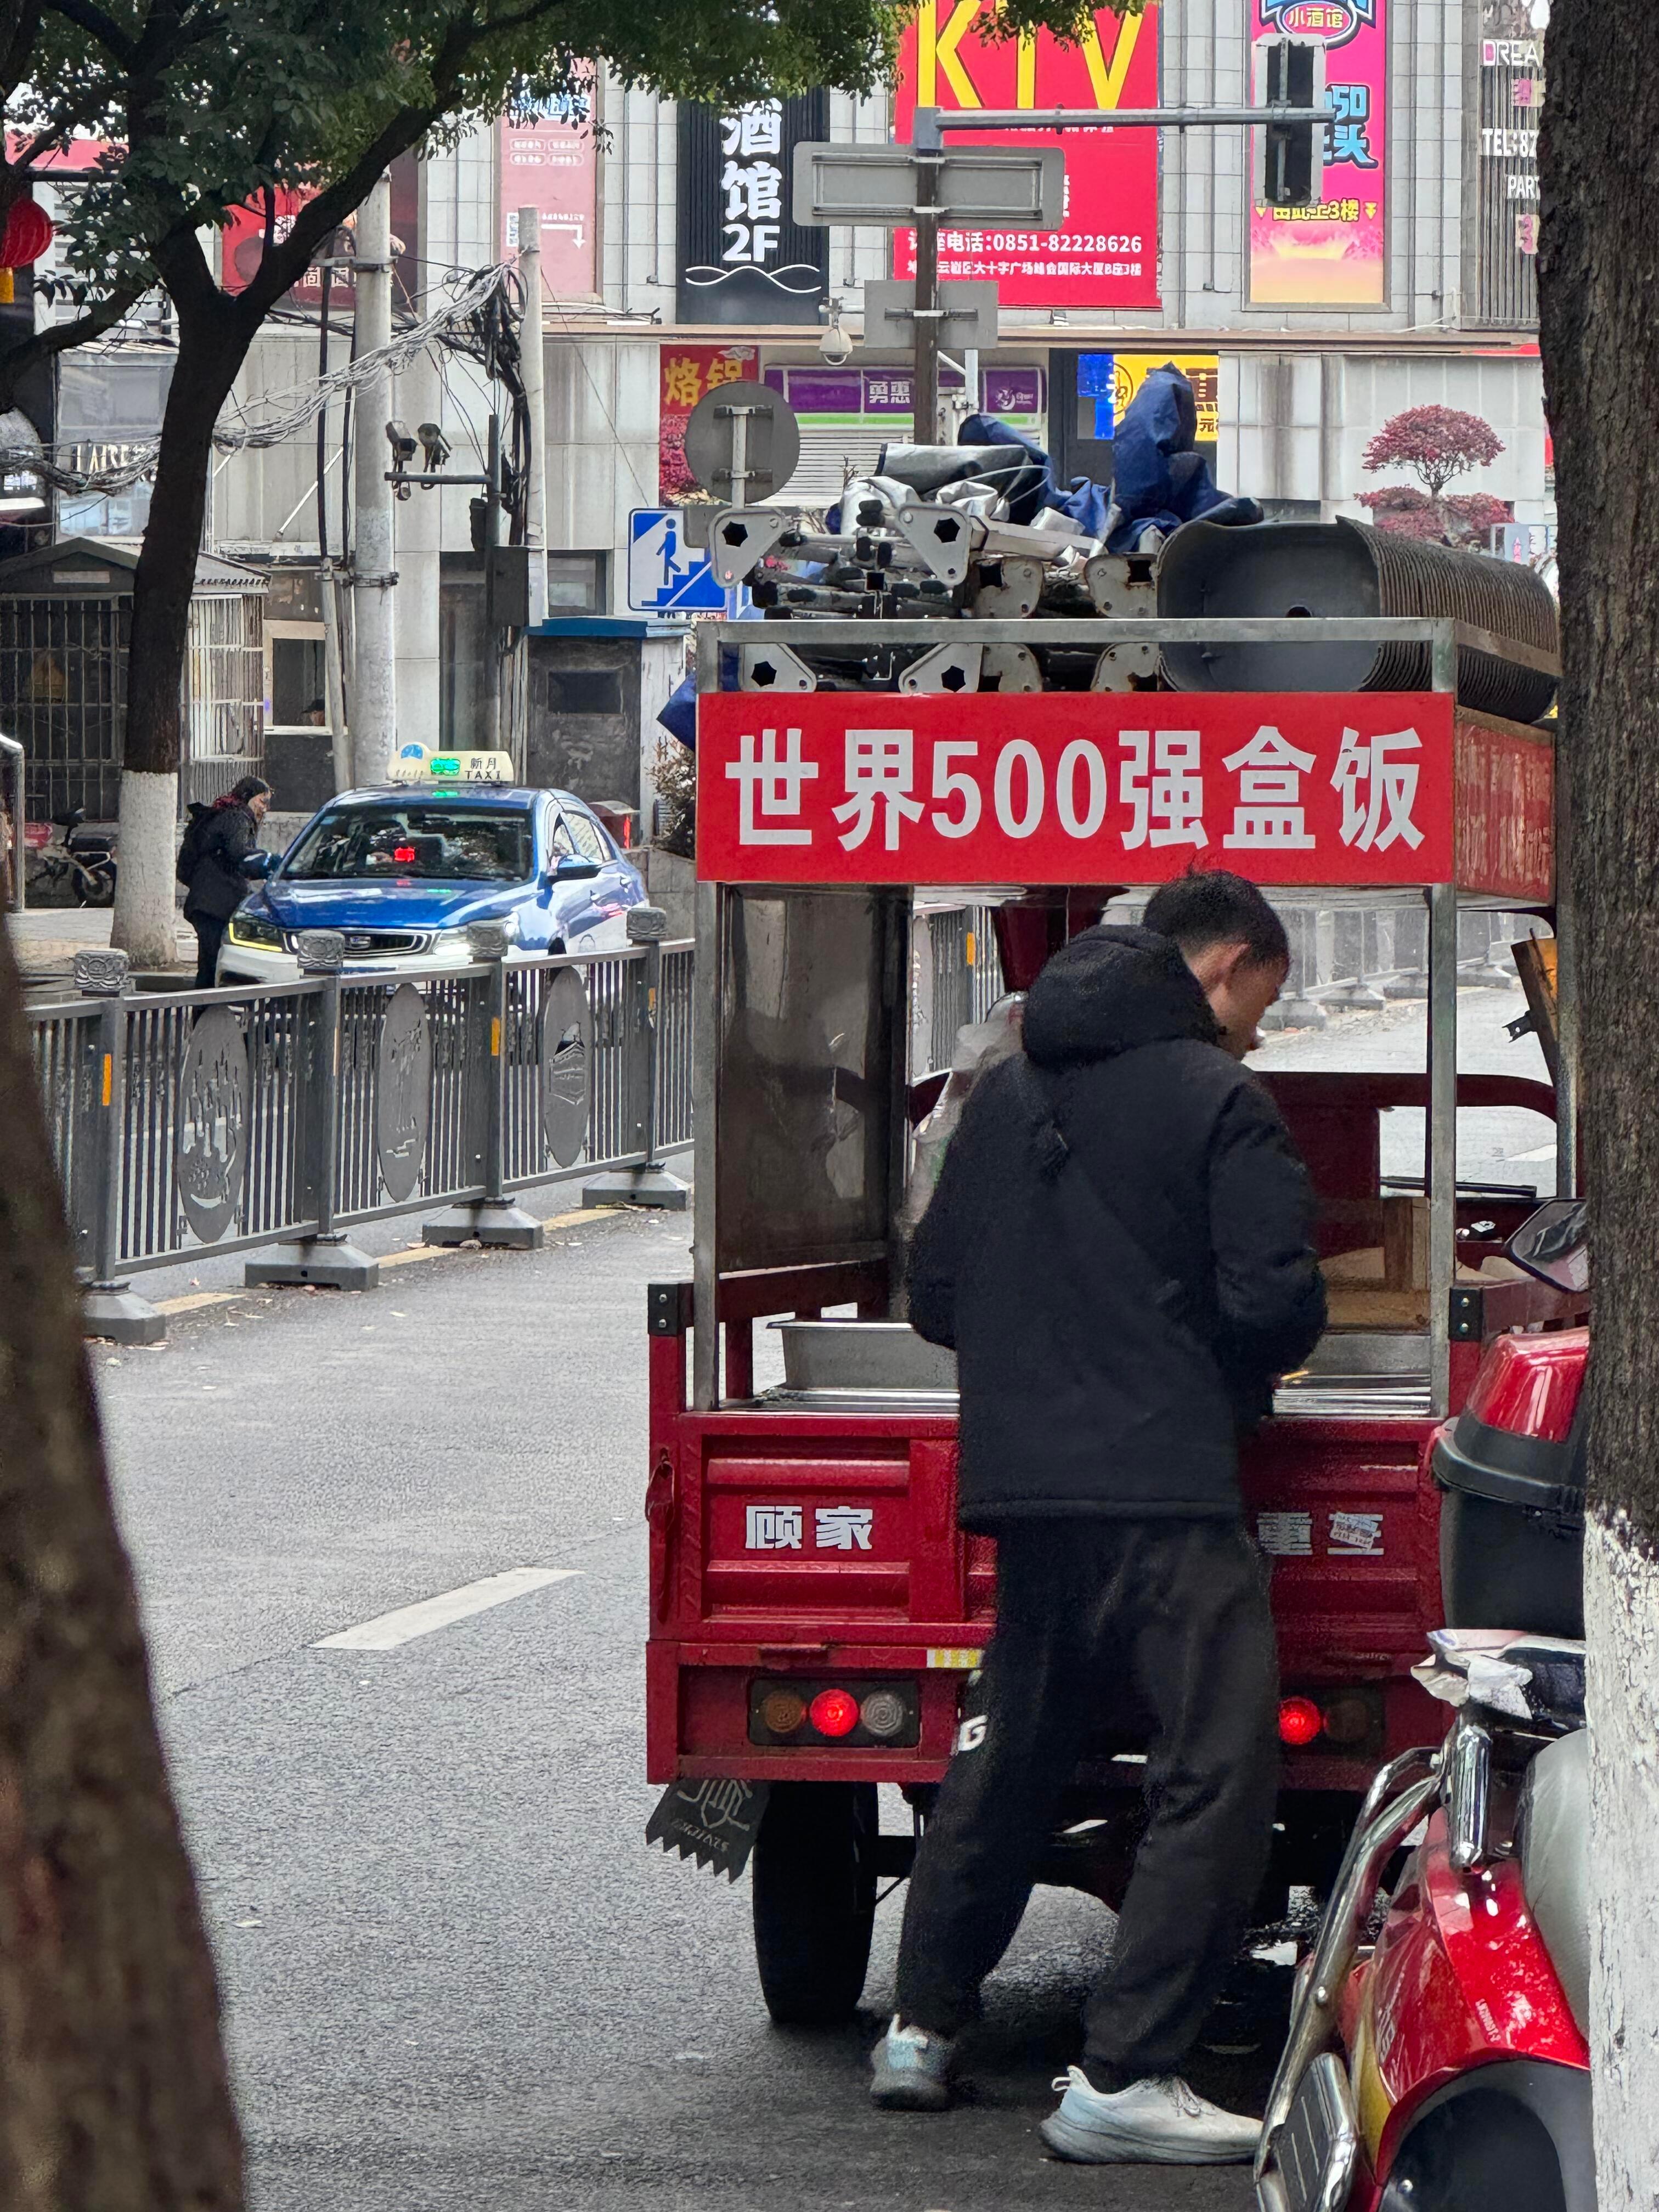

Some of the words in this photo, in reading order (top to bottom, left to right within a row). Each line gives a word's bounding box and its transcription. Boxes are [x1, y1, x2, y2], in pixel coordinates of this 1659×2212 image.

[1289, 7, 1344, 28] 小酒馆
[917, 0, 1143, 110] KTV
[719, 98, 783, 220] 酒馆
[1323, 124, 1375, 163] 头
[723, 224, 780, 262] 2F
[465, 770, 500, 781] TAXI
[724, 725, 1426, 852] 世界500强盒饭
[745, 1505, 873, 1550] 顾家
